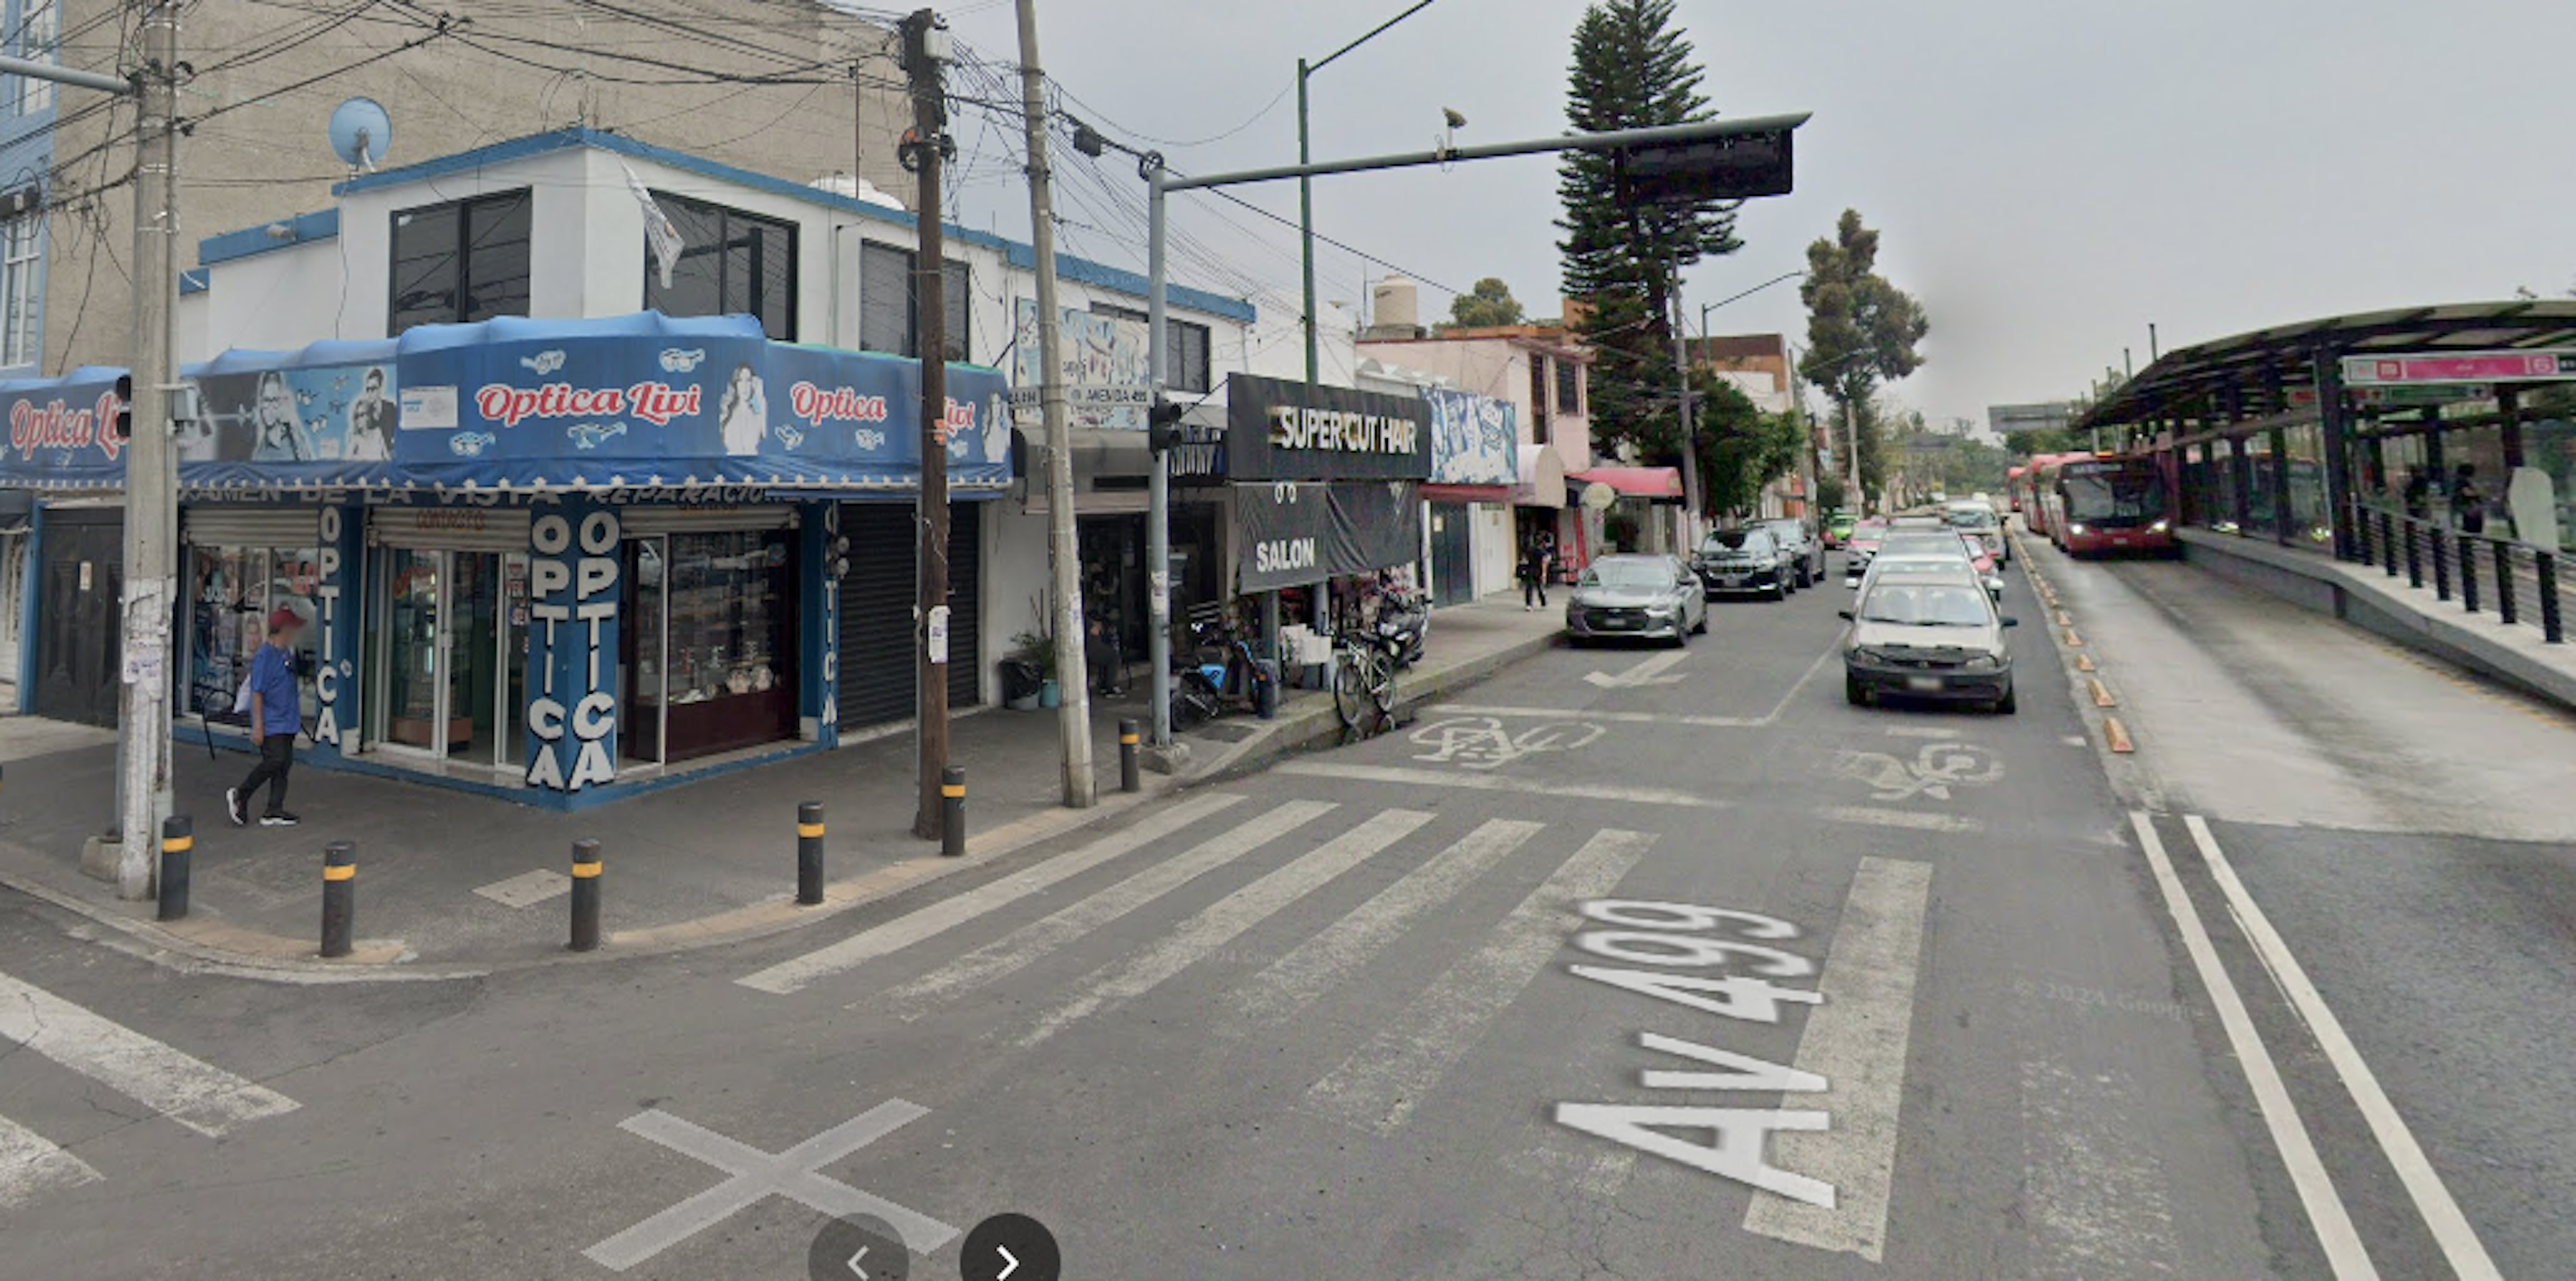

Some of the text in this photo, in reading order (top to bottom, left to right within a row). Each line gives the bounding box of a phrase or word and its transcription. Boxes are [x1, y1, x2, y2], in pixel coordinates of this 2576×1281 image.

[10, 399, 93, 461] Optica
[475, 380, 701, 427] Optica Livi
[790, 380, 888, 426] Optica
[1279, 406, 1417, 454] SUPER CUT HAIR
[1256, 537, 1315, 572] SALON
[315, 506, 341, 745] OPTICA
[525, 514, 572, 790] OPTICA
[570, 511, 620, 790] OPTICA
